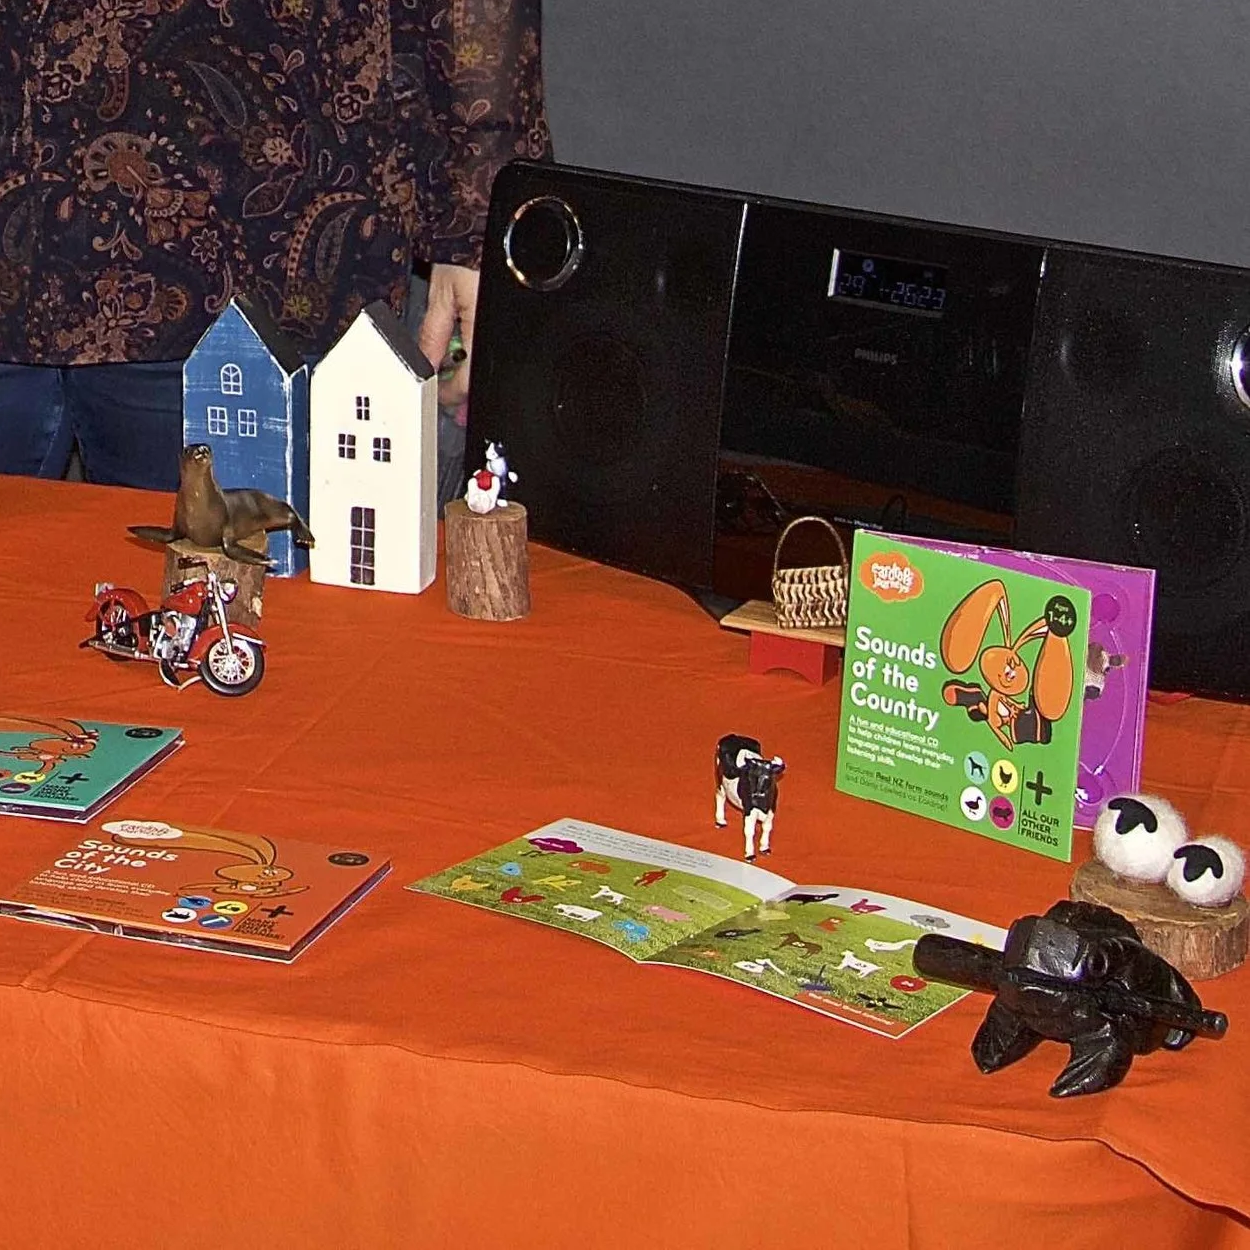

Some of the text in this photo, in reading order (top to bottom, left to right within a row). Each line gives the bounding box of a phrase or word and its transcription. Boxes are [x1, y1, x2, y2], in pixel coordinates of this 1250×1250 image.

[854, 348, 898, 365] PHILIPS
[1049, 611, 1073, 627] 1-4+
[855, 626, 937, 669] Sounds
[852, 657, 919, 692] of the
[850, 681, 939, 731] Country
[893, 777, 903, 786] NZ
[1021, 818, 1051, 834] OTHER
[1022, 809, 1059, 827] ALL OUR
[1021, 828, 1058, 847] FRIENDS
[66, 851, 147, 867] of the
[78, 840, 179, 861] Sounds
[54, 858, 111, 874] City
